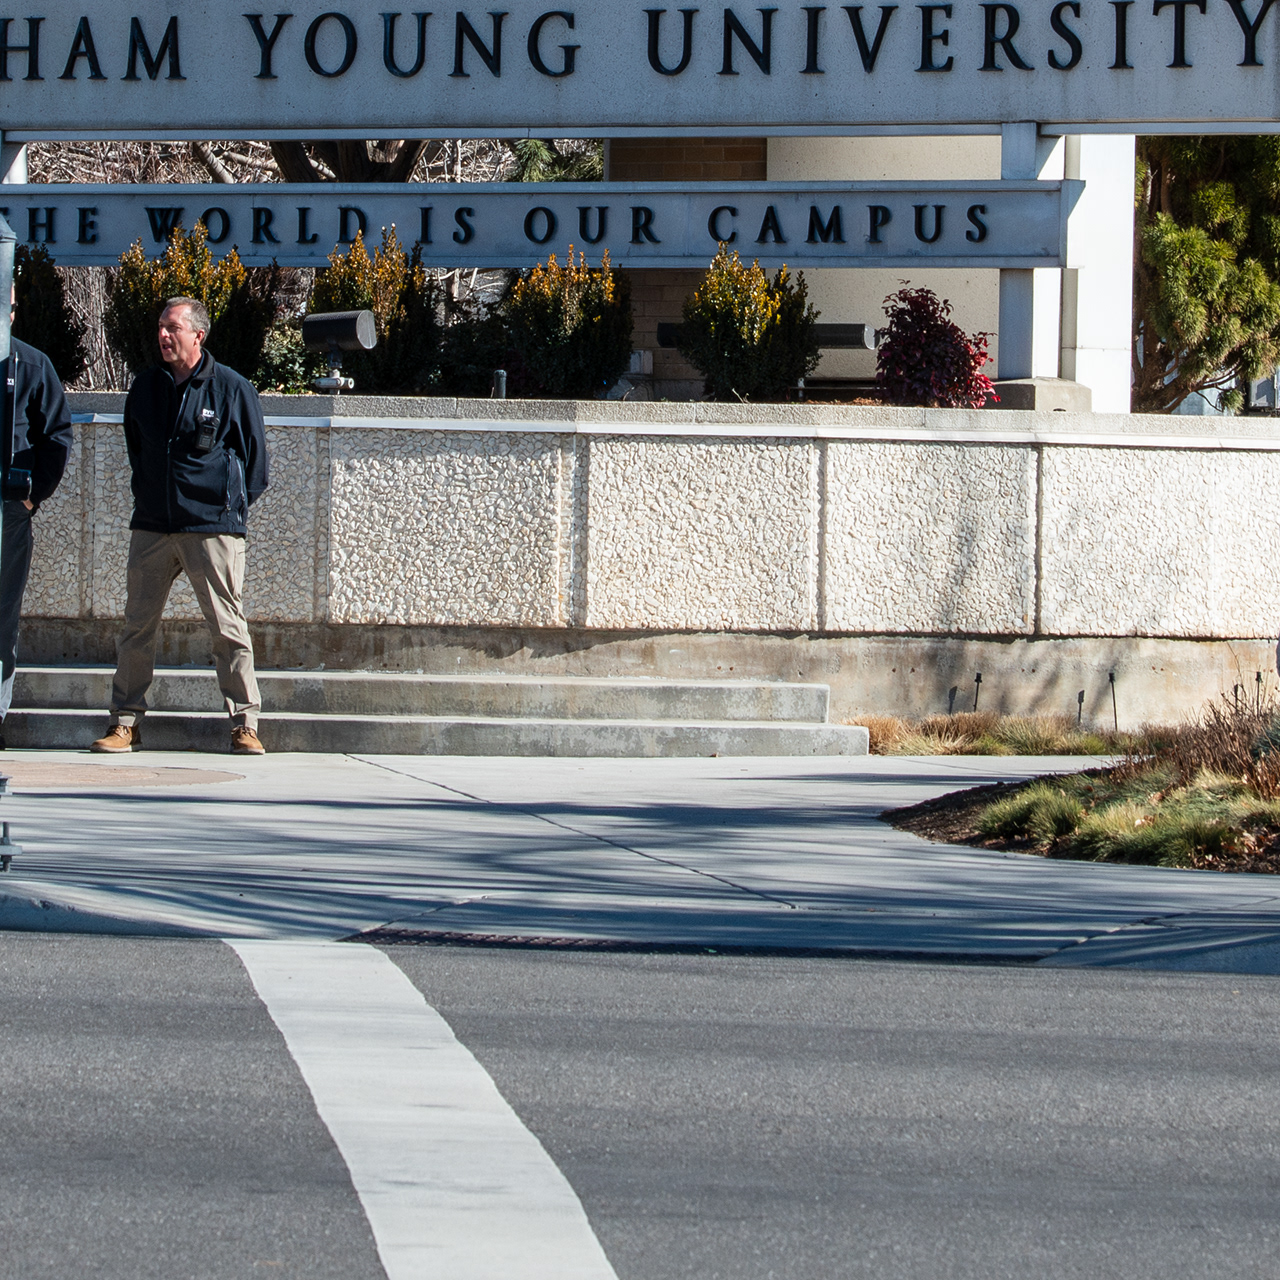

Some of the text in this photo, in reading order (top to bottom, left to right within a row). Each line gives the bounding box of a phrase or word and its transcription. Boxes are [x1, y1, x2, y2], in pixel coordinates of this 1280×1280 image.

[243, 10, 580, 78] YOUNG
[145, 206, 368, 244] WORLD
[419, 206, 476, 244] IS
[523, 205, 662, 244] OUR
[707, 204, 989, 244] CAMPUS
